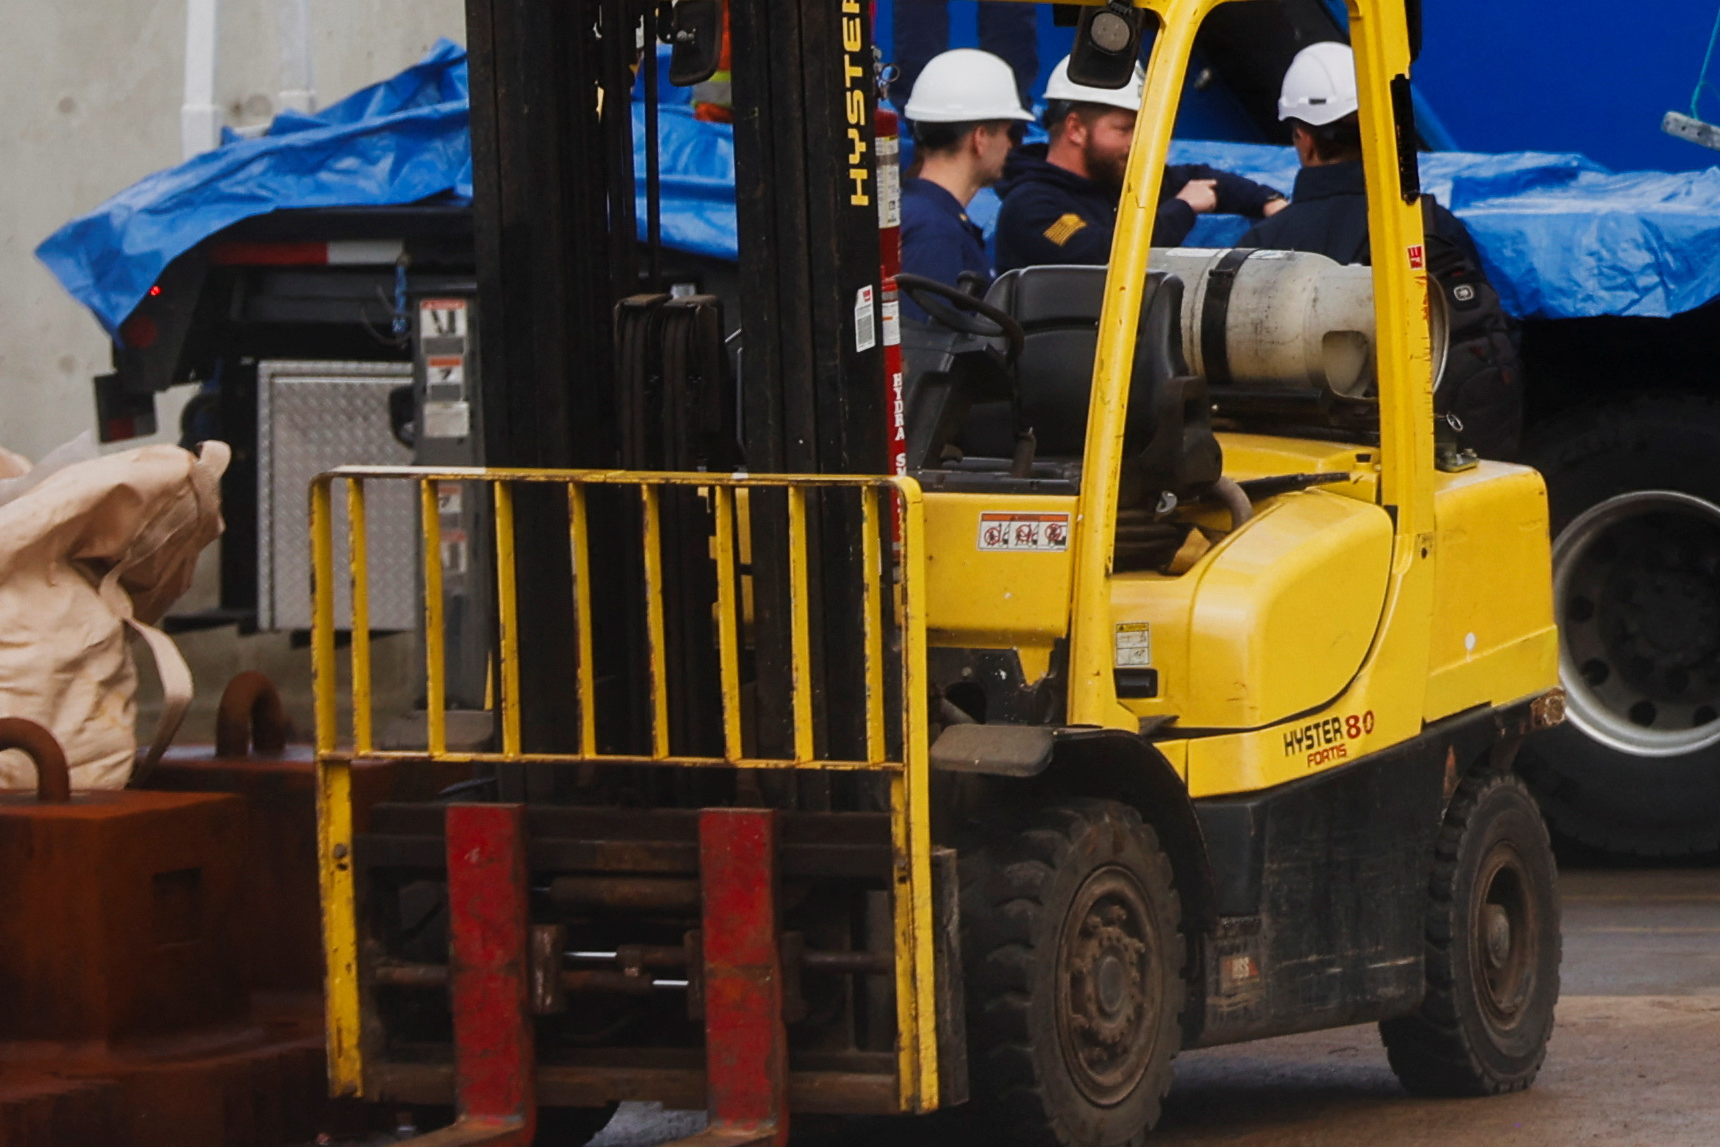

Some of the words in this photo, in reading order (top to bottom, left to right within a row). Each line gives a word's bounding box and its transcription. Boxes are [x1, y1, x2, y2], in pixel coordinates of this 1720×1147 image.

[892, 373, 905, 441] HYDRA
[1283, 716, 1343, 757] HYSTER
[1345, 710, 1375, 740] 80
[1307, 743, 1348, 768] FORTIS
